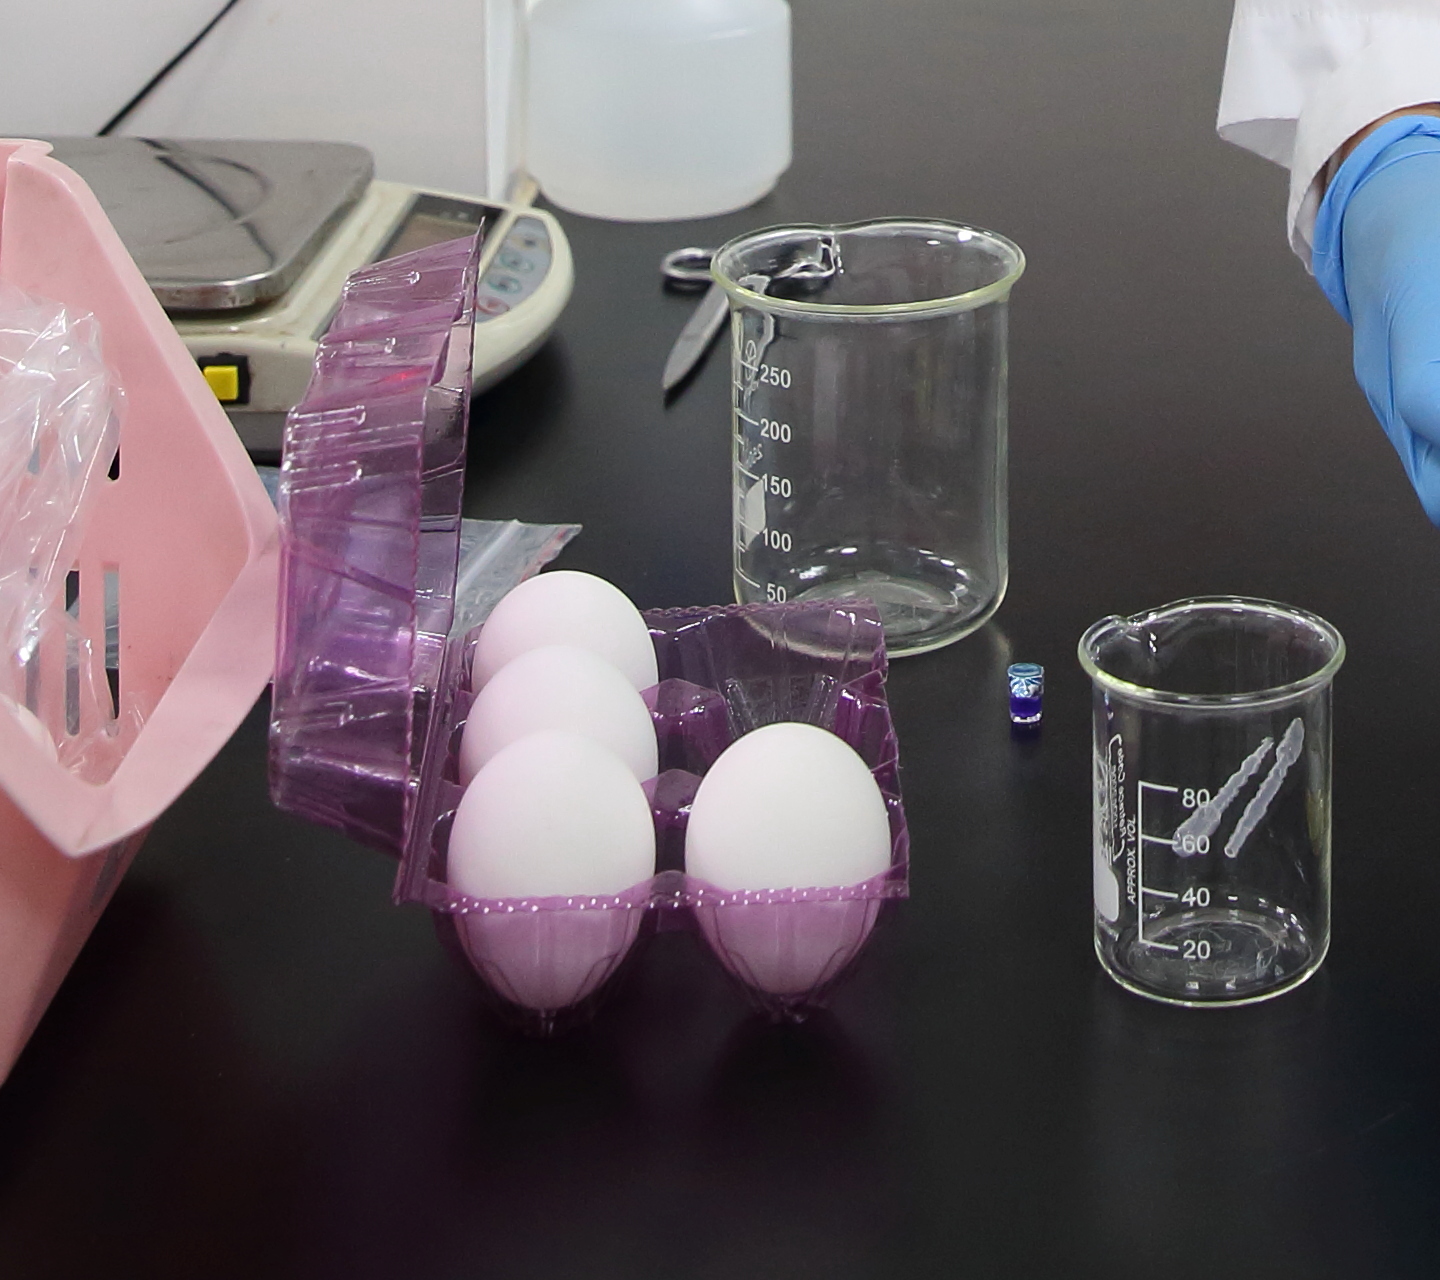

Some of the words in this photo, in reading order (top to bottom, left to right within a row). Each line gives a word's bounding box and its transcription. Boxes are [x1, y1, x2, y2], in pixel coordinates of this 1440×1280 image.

[760, 363, 791, 389] 250
[760, 418, 791, 443] 200
[762, 473, 792, 498] 150
[762, 527, 792, 552] 100
[766, 582, 787, 604] 50
[1182, 788, 1211, 809] 80
[1182, 834, 1211, 855] 60
[1181, 887, 1211, 907] 40
[1182, 939, 1211, 960] 20
